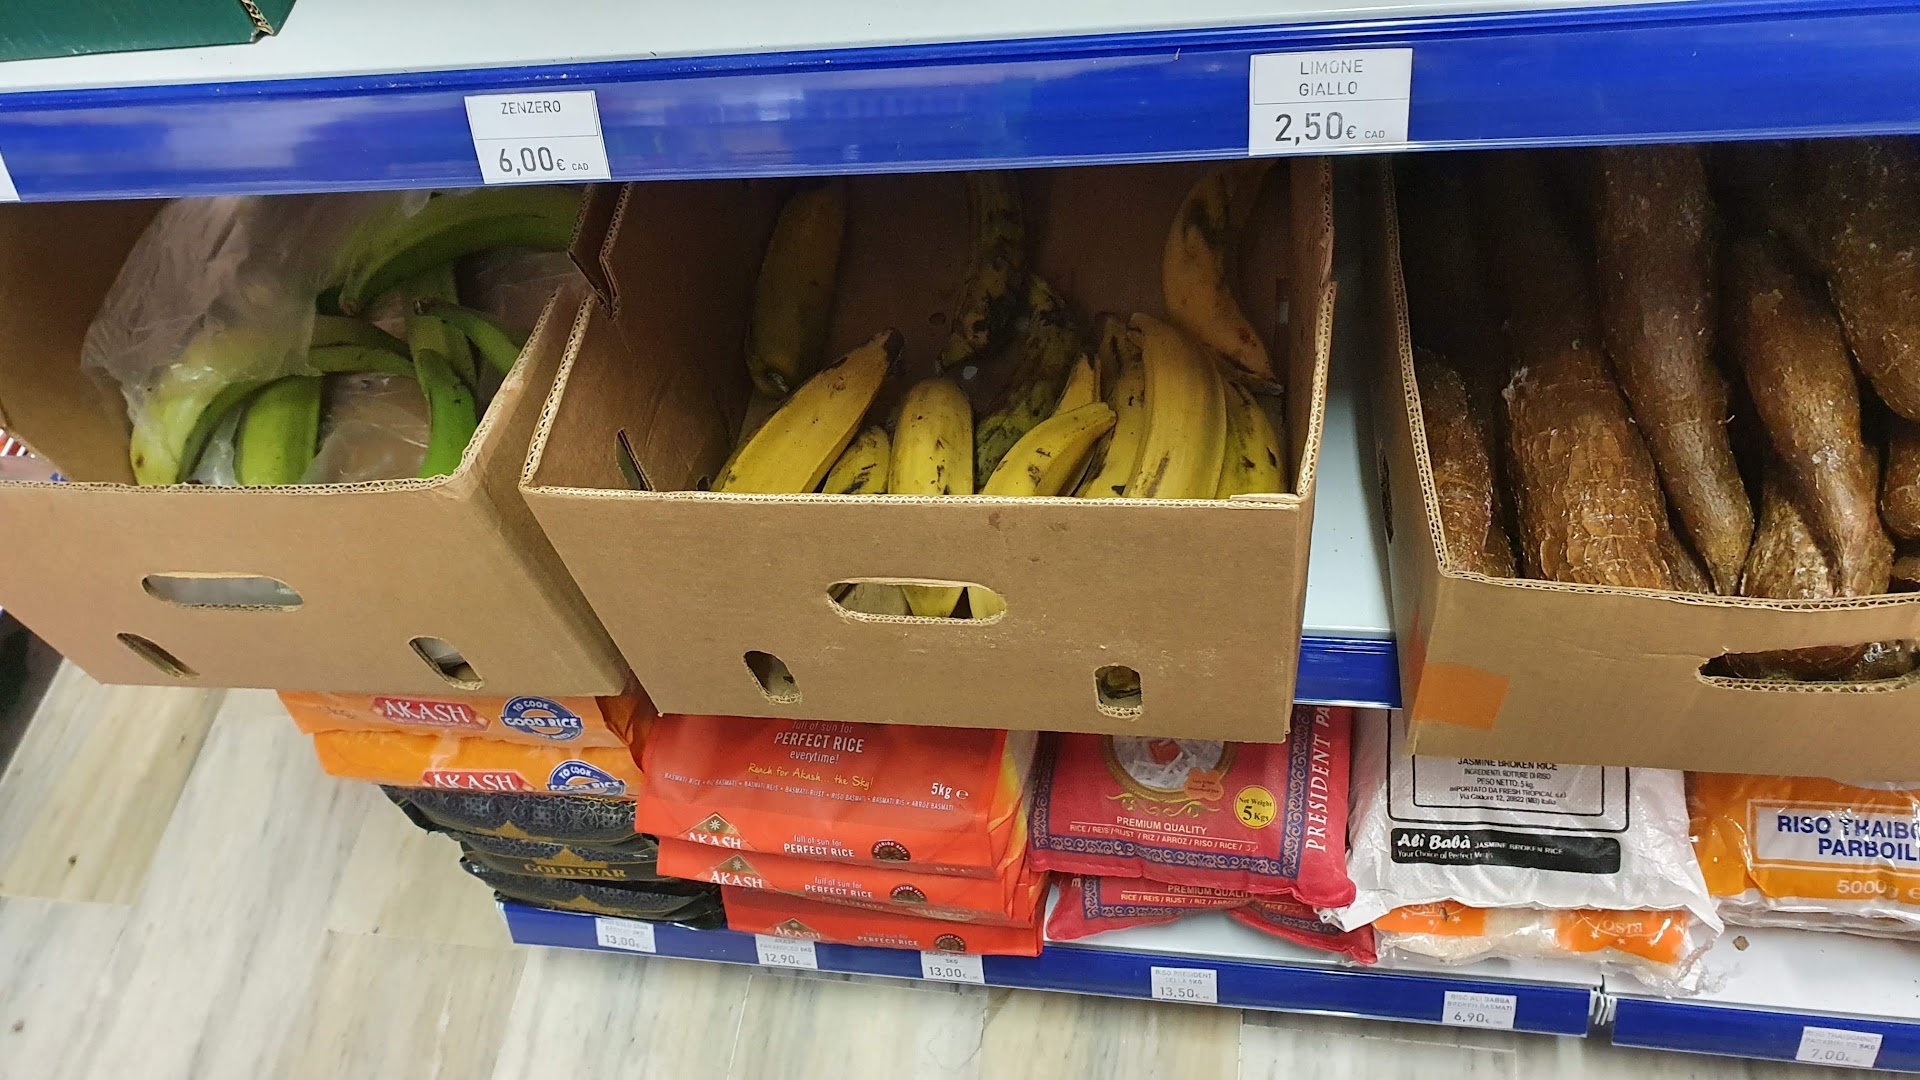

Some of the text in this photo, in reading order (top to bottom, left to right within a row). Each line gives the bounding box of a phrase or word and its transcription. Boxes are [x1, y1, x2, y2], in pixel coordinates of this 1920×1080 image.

[1300, 59, 1363, 75] LIMONE
[1299, 81, 1358, 96] GIALLO
[501, 100, 561, 115] ZENZERO
[1275, 111, 1385, 146] 2,50€ CAD
[500, 146, 589, 176] 6,00€ CAD
[384, 699, 470, 723] AKASH
[512, 700, 549, 712] TO COOK
[504, 717, 580, 728] GOOD RICE
[809, 721, 819, 731] of
[821, 723, 838, 731] sun
[839, 722, 853, 734] for
[773, 732, 865, 753] PERFECT RICE
[789, 750, 839, 764] everytime!
[1457, 757, 1497, 767] JASMINE
[558, 766, 592, 779] TO COOK
[748, 762, 773, 775] Reach
[775, 765, 789, 777] for
[834, 773, 848, 785] the
[852, 775, 874, 791] Sky!
[433, 773, 517, 791] AKASH
[1476, 777, 1495, 786] PESO
[931, 782, 952, 800] 5kg
[1305, 732, 1331, 853] PRESIDENT
[1498, 787, 1521, 795] FRESH
[1522, 789, 1553, 798] TROPICAL
[1251, 798, 1272, 807] Weight
[1242, 805, 1253, 821] 5
[1116, 816, 1207, 835] PREMIUM QUALITY
[1777, 815, 1832, 834] RISO
[688, 832, 741, 849] AKASH
[793, 834, 842, 847] full of sun for
[1069, 824, 1086, 832] RICE
[1092, 826, 1109, 834] REIS
[1142, 833, 1155, 841] RIZ
[1161, 836, 1187, 845] ARROZ
[1193, 838, 1213, 847] RISO
[1219, 842, 1238, 850] RICE
[1428, 834, 1471, 850] Babà
[783, 843, 855, 857] PERFECT RICE
[1397, 849, 1414, 858] Your
[1414, 850, 1439, 858] Choice
[1439, 851, 1447, 859] of
[1818, 838, 1920, 861] PARBOIL
[524, 863, 627, 878] GOLD STAR
[710, 870, 763, 888] AKASH
[814, 876, 826, 885] full
[838, 880, 851, 888] sun
[852, 881, 862, 889] for
[1836, 879, 1887, 894] 5000
[804, 884, 873, 899] PERFECT RICE
[1120, 893, 1137, 902] RICE
[1143, 895, 1160, 903] REIS
[1167, 885, 1212, 896] PREMIUM
[857, 935, 895, 944] PERFECT
[898, 939, 919, 947] RICE
